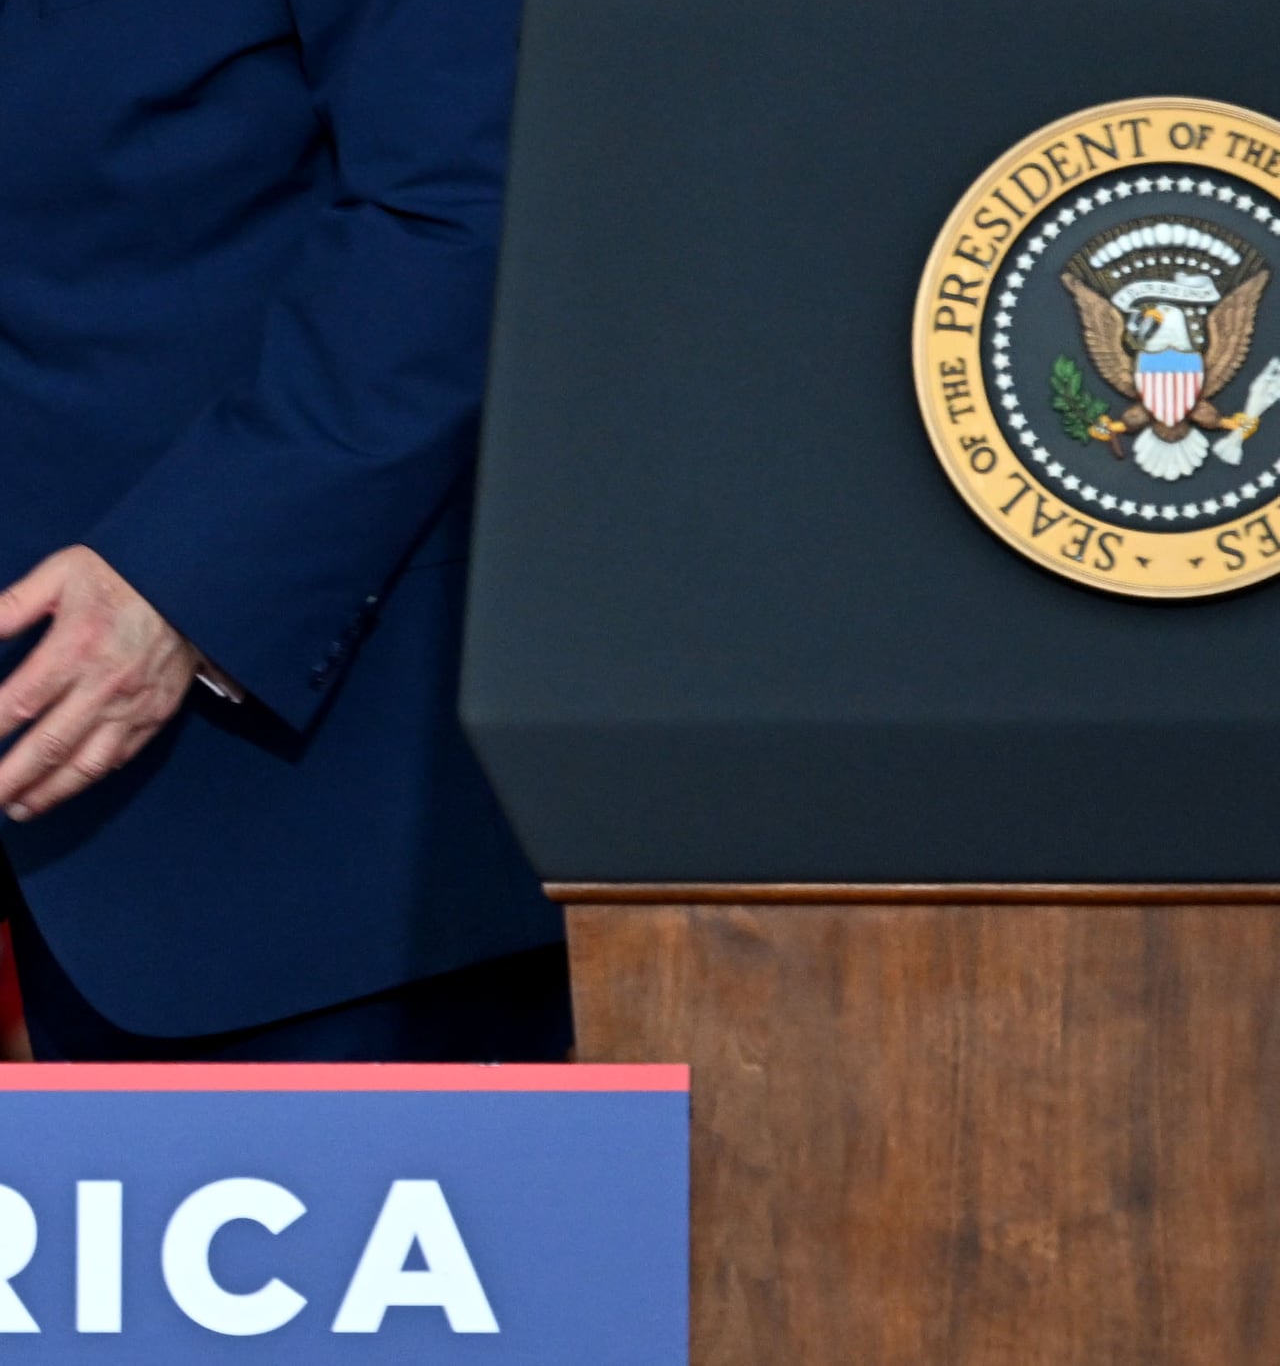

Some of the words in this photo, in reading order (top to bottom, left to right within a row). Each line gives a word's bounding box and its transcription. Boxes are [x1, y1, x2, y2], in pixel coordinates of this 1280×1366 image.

[1168, 121, 1215, 151] OF
[1224, 129, 1280, 179] THE
[933, 117, 1152, 336] PRESIDENT
[940, 356, 977, 425] THE
[959, 433, 999, 475] OF
[1000, 472, 1125, 572] SEAL
